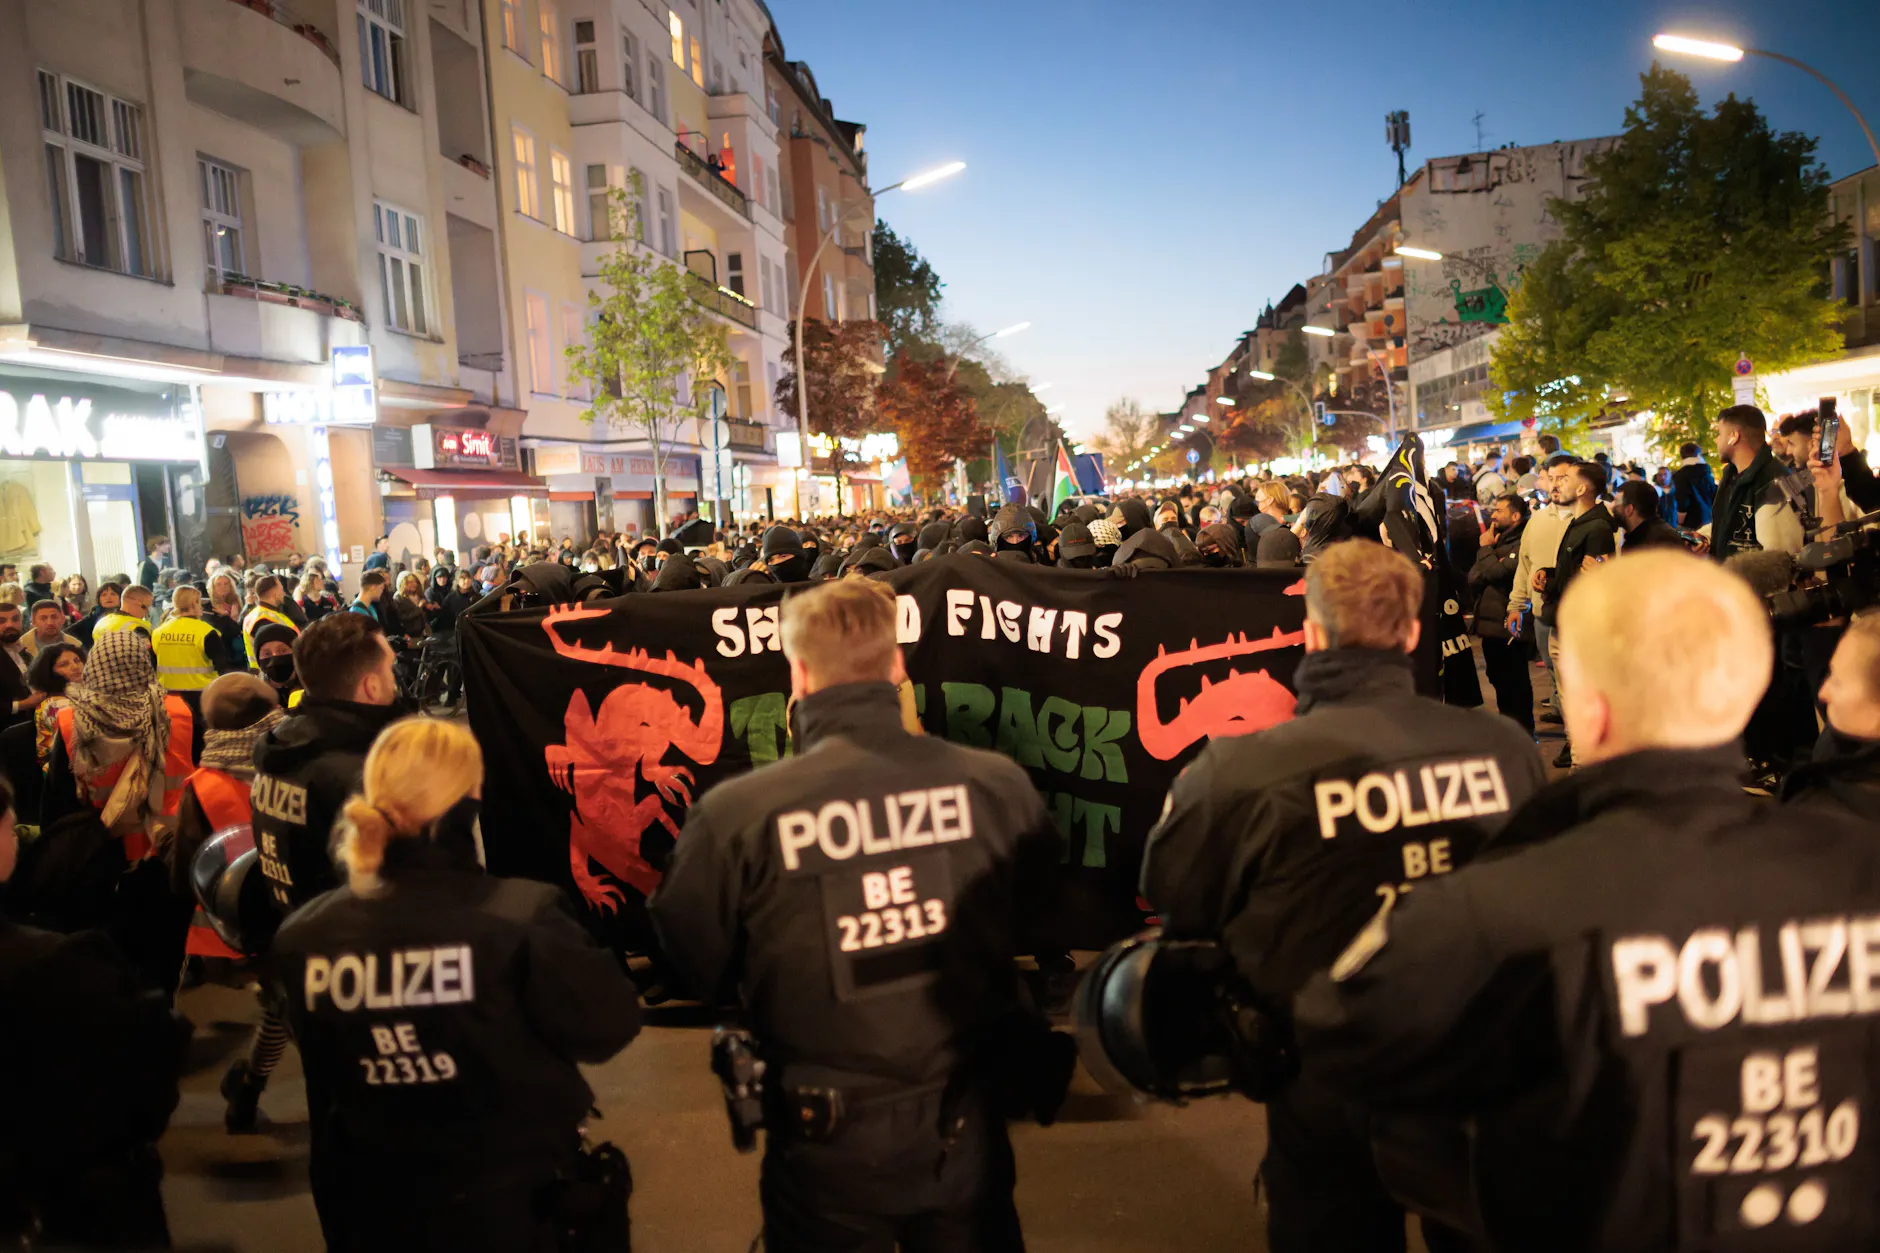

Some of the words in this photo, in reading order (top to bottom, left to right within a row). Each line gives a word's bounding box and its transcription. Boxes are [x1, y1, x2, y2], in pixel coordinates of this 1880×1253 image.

[461, 432, 491, 456] Simit
[160, 632, 195, 642] POLIZEI
[946, 589, 1123, 660] FIGHTS
[941, 682, 1131, 783] BACK
[249, 773, 308, 825] POLIZEI
[777, 784, 974, 871] POLIZEI
[1314, 757, 1511, 840] POLIZEI
[862, 866, 917, 910] BE
[1402, 837, 1453, 880] BE
[836, 899, 948, 952] 22313
[305, 945, 475, 1013] POLIZEI
[1611, 914, 1880, 1037] POLIZE
[358, 1052, 459, 1085] 22319
[371, 1022, 421, 1055] BE
[1741, 1047, 1819, 1114] BE
[1691, 1098, 1859, 1175] 22310
